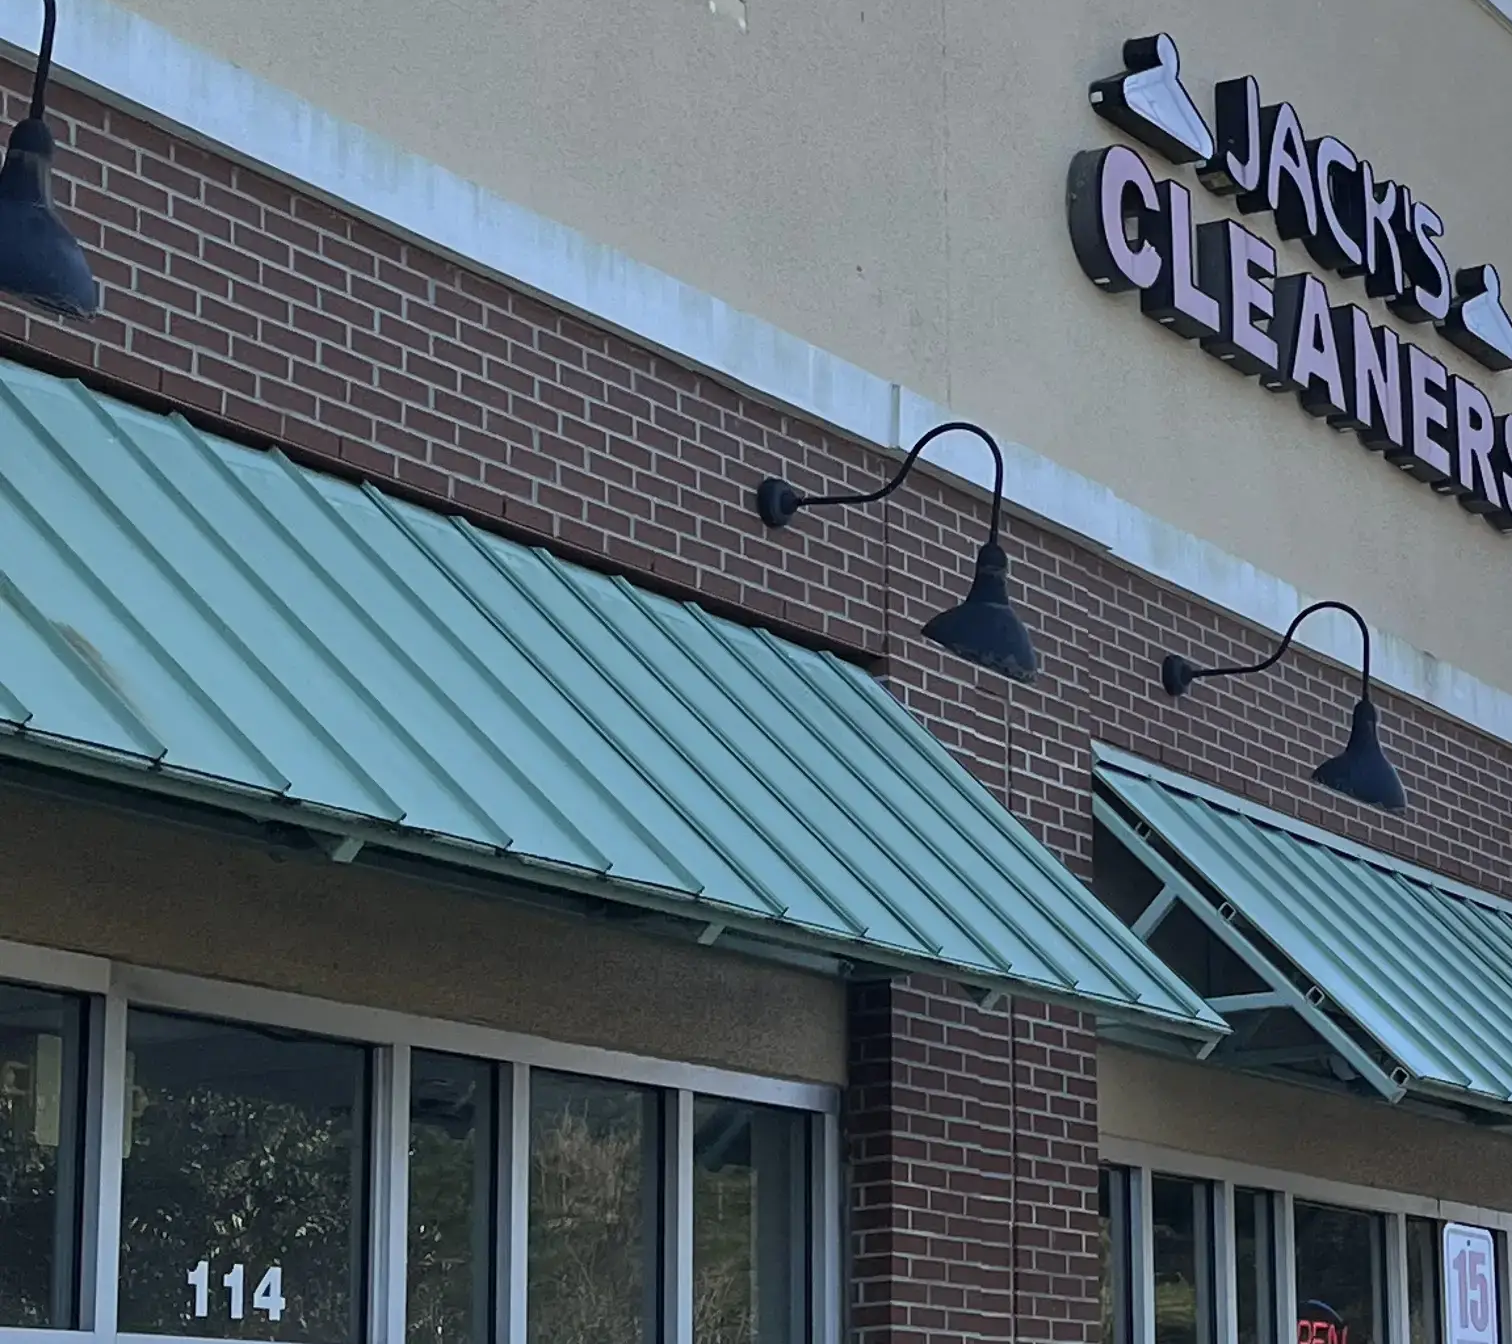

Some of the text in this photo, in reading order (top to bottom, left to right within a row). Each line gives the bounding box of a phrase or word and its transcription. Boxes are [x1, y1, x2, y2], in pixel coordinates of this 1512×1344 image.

[1215, 74, 1450, 322] JACK'S
[187, 1260, 286, 1321] 114
[1453, 1249, 1489, 1333] 15
